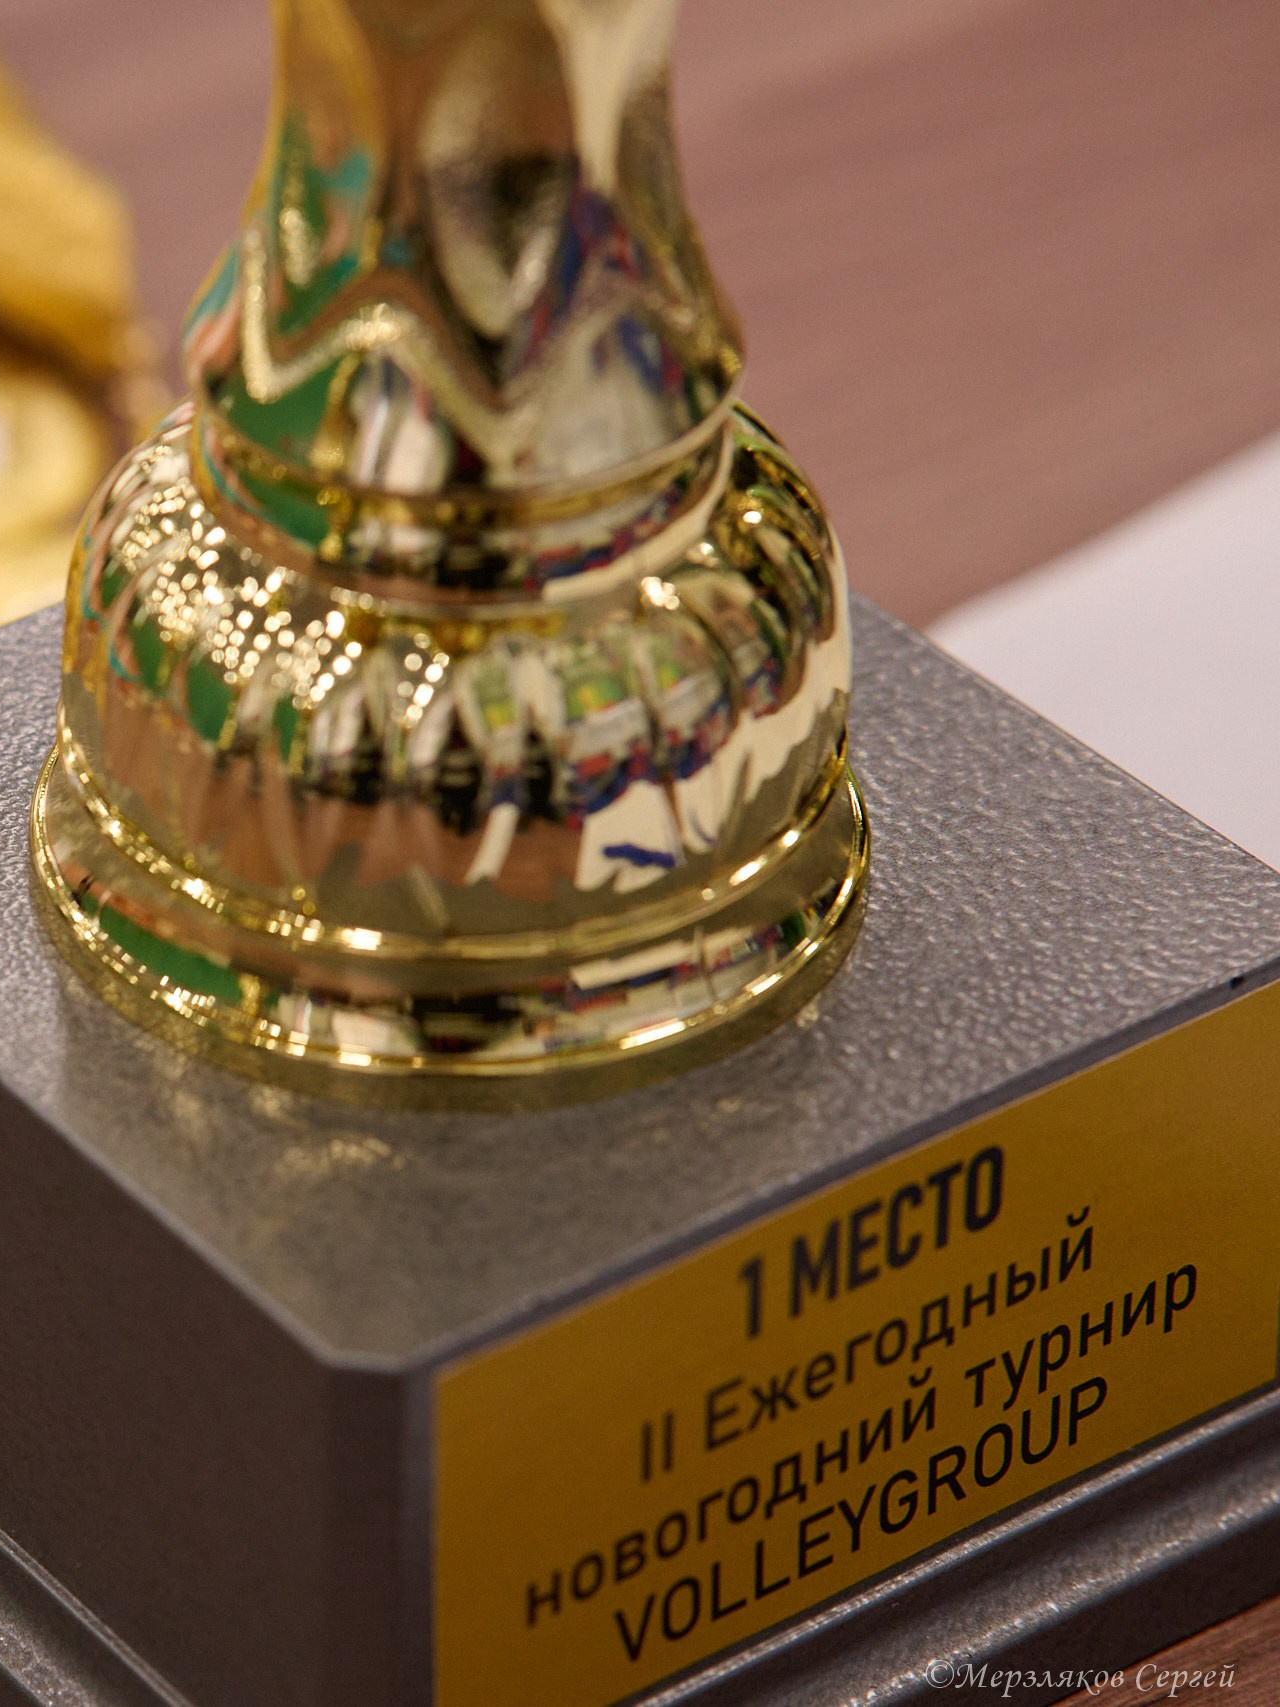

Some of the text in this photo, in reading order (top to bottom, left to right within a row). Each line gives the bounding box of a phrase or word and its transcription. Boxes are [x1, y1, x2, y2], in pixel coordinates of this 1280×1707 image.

[703, 1206, 1094, 1452] Ежегодный
[739, 1146, 1005, 1340] 1 МЕСТО
[525, 1262, 1198, 1626] новогодний турнир
[613, 1376, 1109, 1663] VOLLEYGROUP
